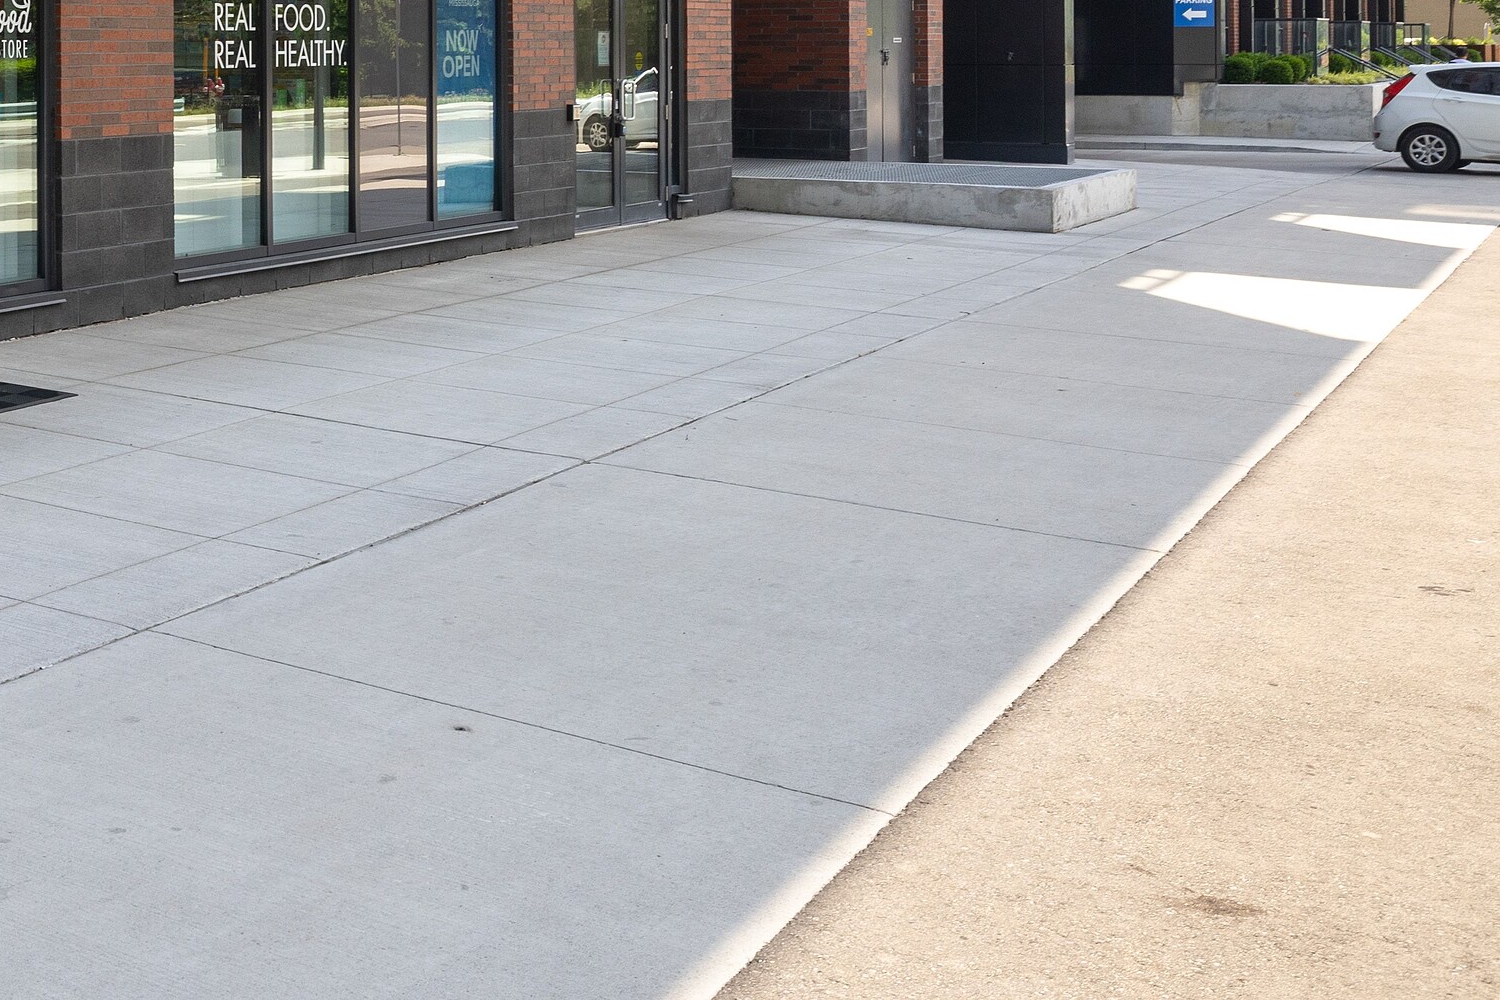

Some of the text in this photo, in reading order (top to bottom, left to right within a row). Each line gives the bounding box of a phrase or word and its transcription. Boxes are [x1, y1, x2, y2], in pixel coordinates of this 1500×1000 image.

[214, 2, 331, 31] REAL FOOD.
[446, 29, 479, 52] NOW
[214, 39, 348, 69] REAL HEALTHY.
[442, 55, 480, 78] OPEN
